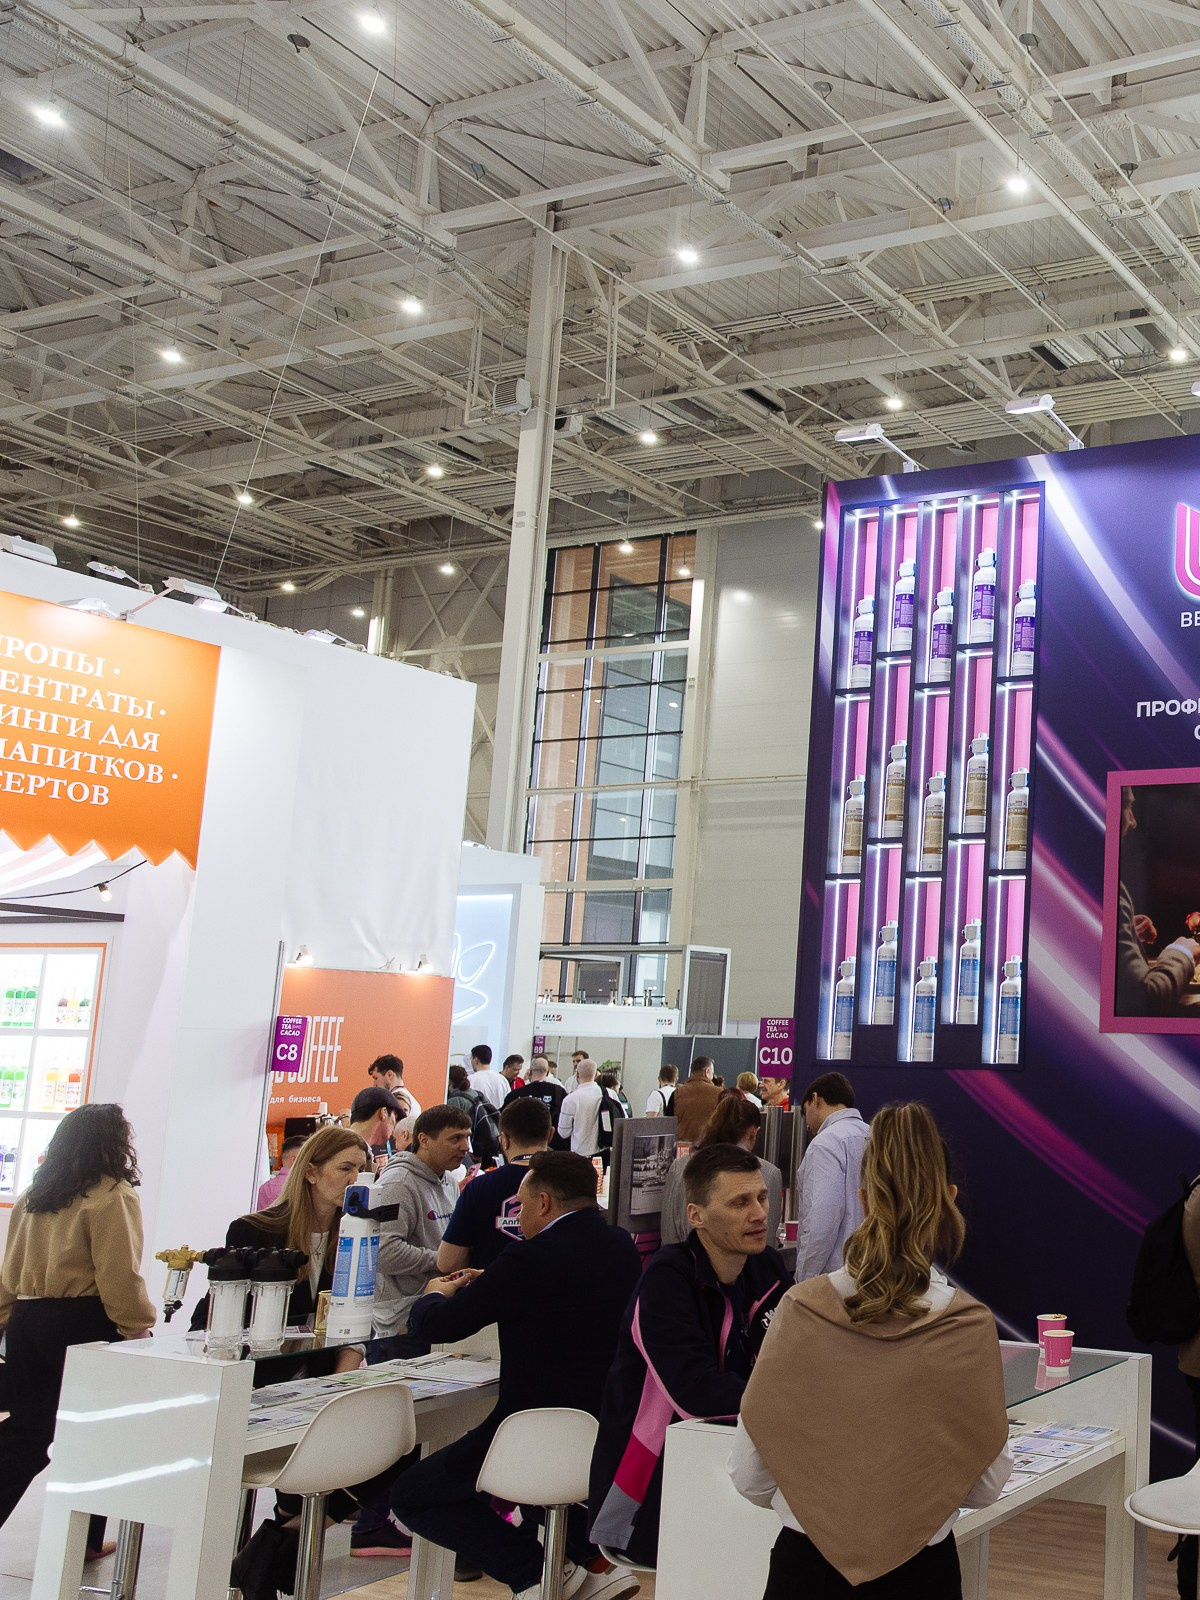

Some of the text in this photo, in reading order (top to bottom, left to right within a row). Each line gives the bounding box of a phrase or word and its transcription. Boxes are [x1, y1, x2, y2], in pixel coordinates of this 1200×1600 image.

[98, 724, 160, 752] ДЛЯ
[0, 769, 110, 806] ЕРТОВ
[276, 1043, 298, 1061] C8
[759, 1046, 793, 1065] C10
[289, 1095, 321, 1103] бизнеса
